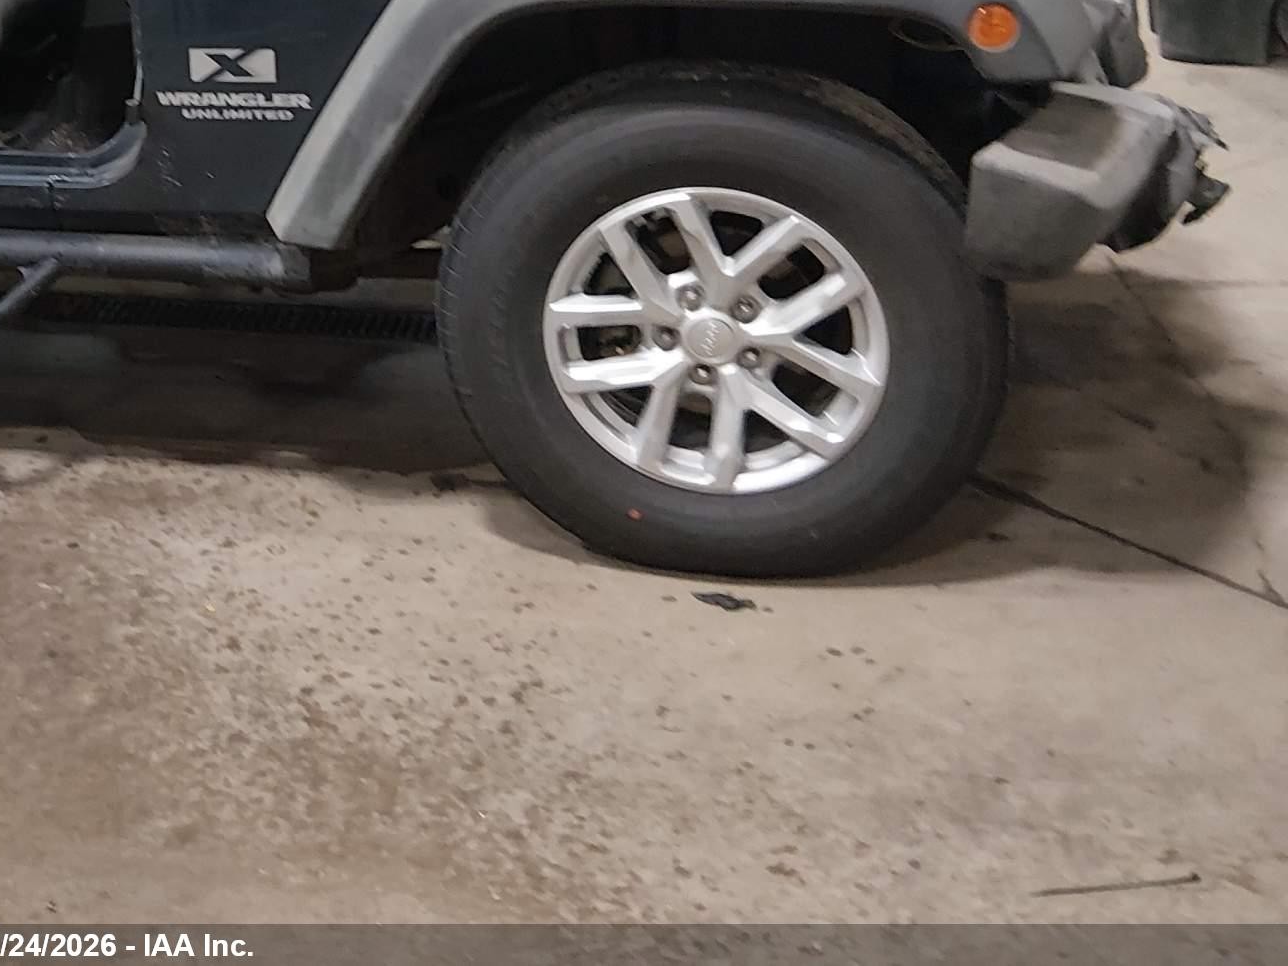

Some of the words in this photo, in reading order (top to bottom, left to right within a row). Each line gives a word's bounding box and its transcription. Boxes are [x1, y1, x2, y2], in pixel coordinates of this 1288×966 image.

[201, 48, 260, 83] X
[155, 90, 313, 110] WRANGLER
[181, 108, 295, 121] UNLIMITED
